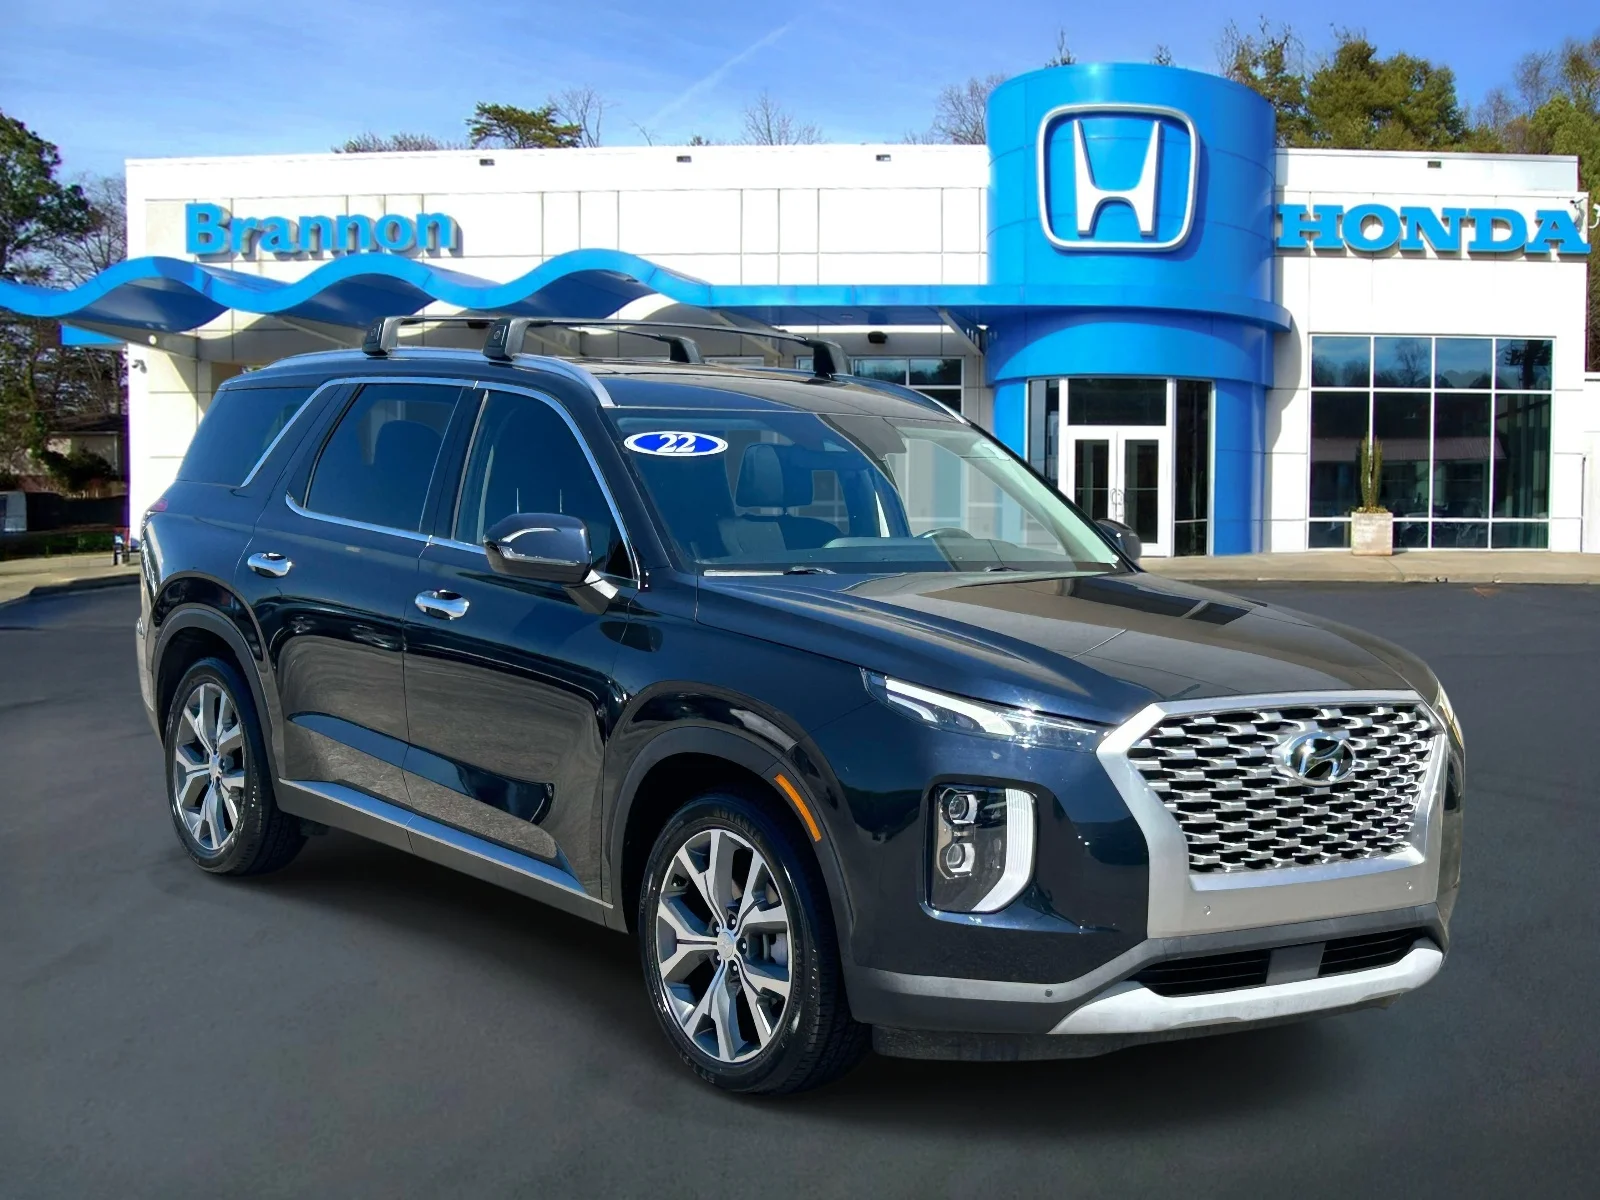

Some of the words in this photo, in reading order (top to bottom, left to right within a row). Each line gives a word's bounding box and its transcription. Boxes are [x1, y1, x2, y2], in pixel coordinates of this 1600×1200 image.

[185, 202, 454, 256] Brannon
[1277, 203, 1592, 255] HONDA
[656, 433, 697, 453] 22
